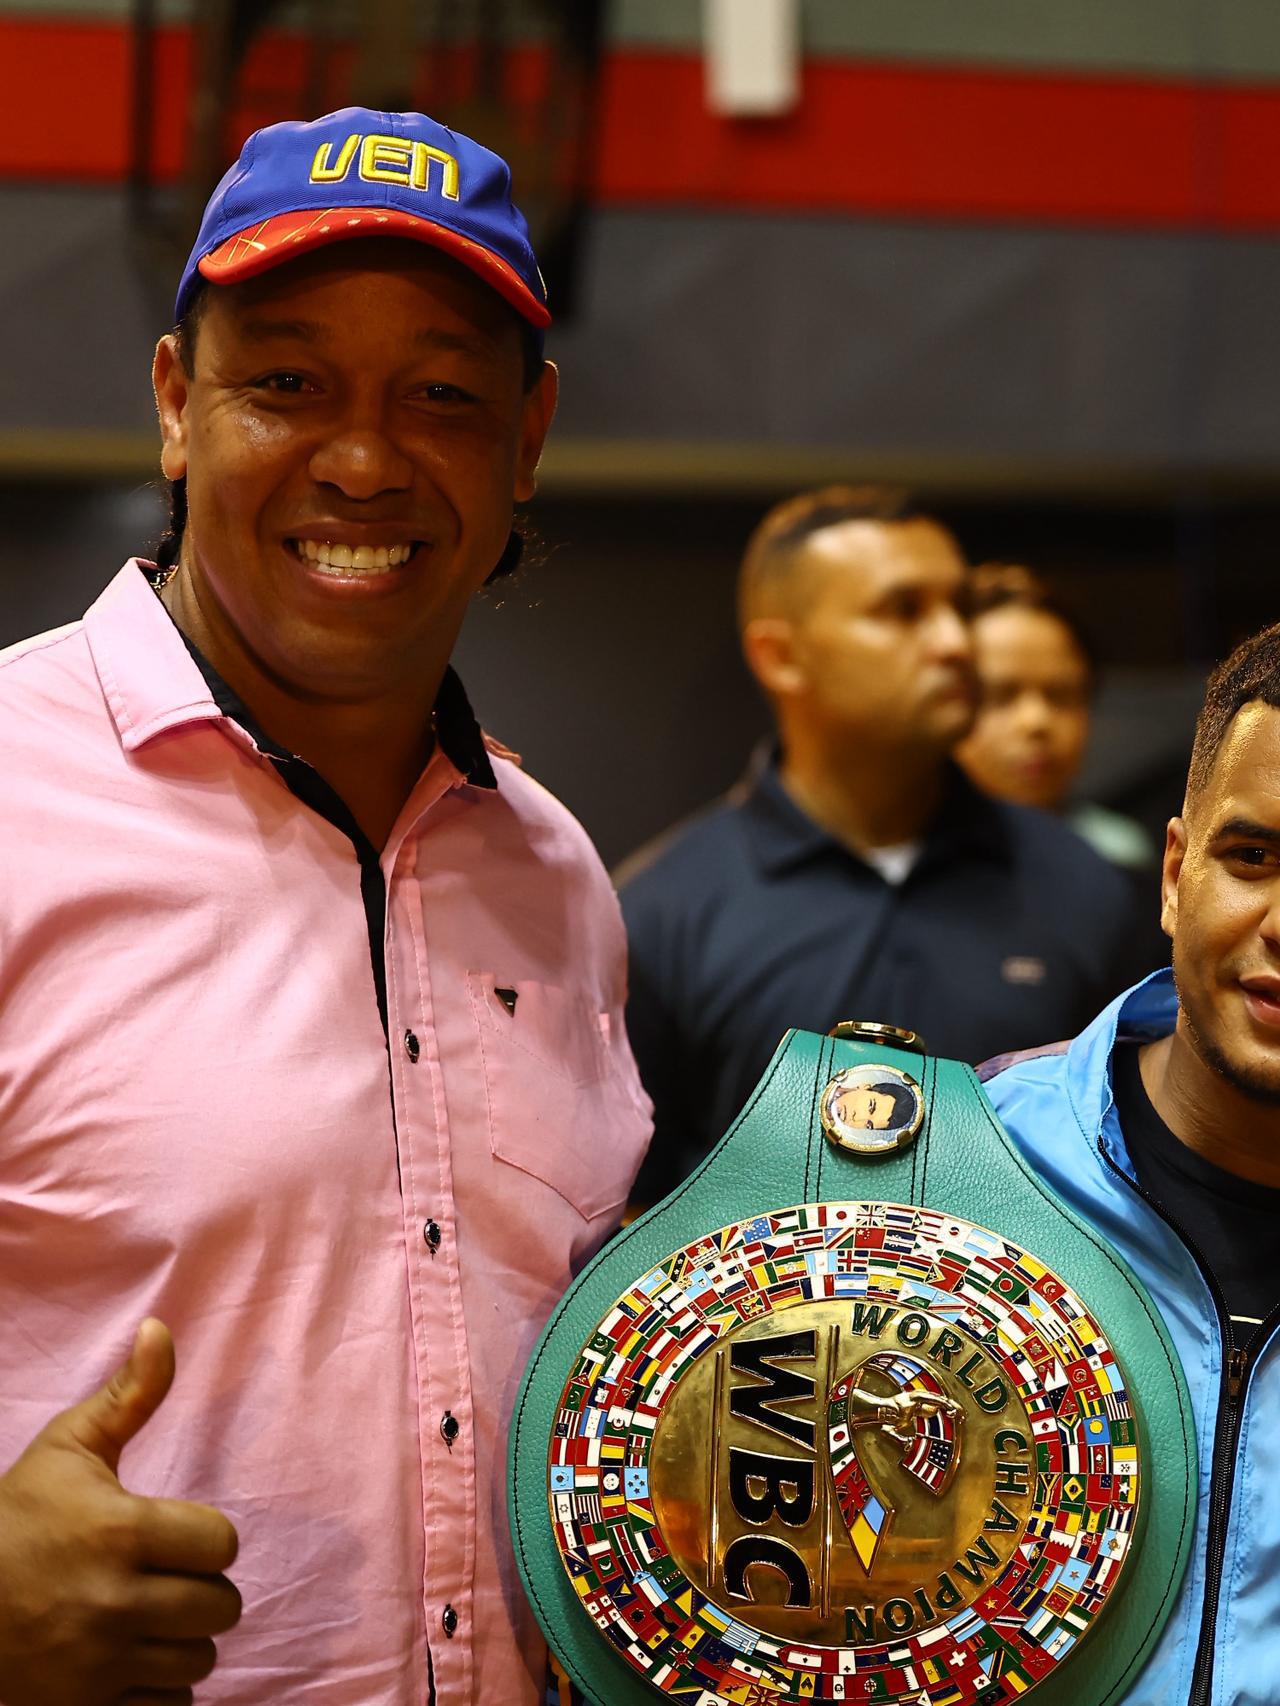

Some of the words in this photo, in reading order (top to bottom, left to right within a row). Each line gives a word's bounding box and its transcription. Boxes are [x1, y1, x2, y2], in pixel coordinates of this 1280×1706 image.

[308, 133, 460, 202] VEN
[850, 1302, 1009, 1414] WORLD
[722, 1328, 818, 1611] WBC
[844, 1428, 1030, 1643] CHAMPION
